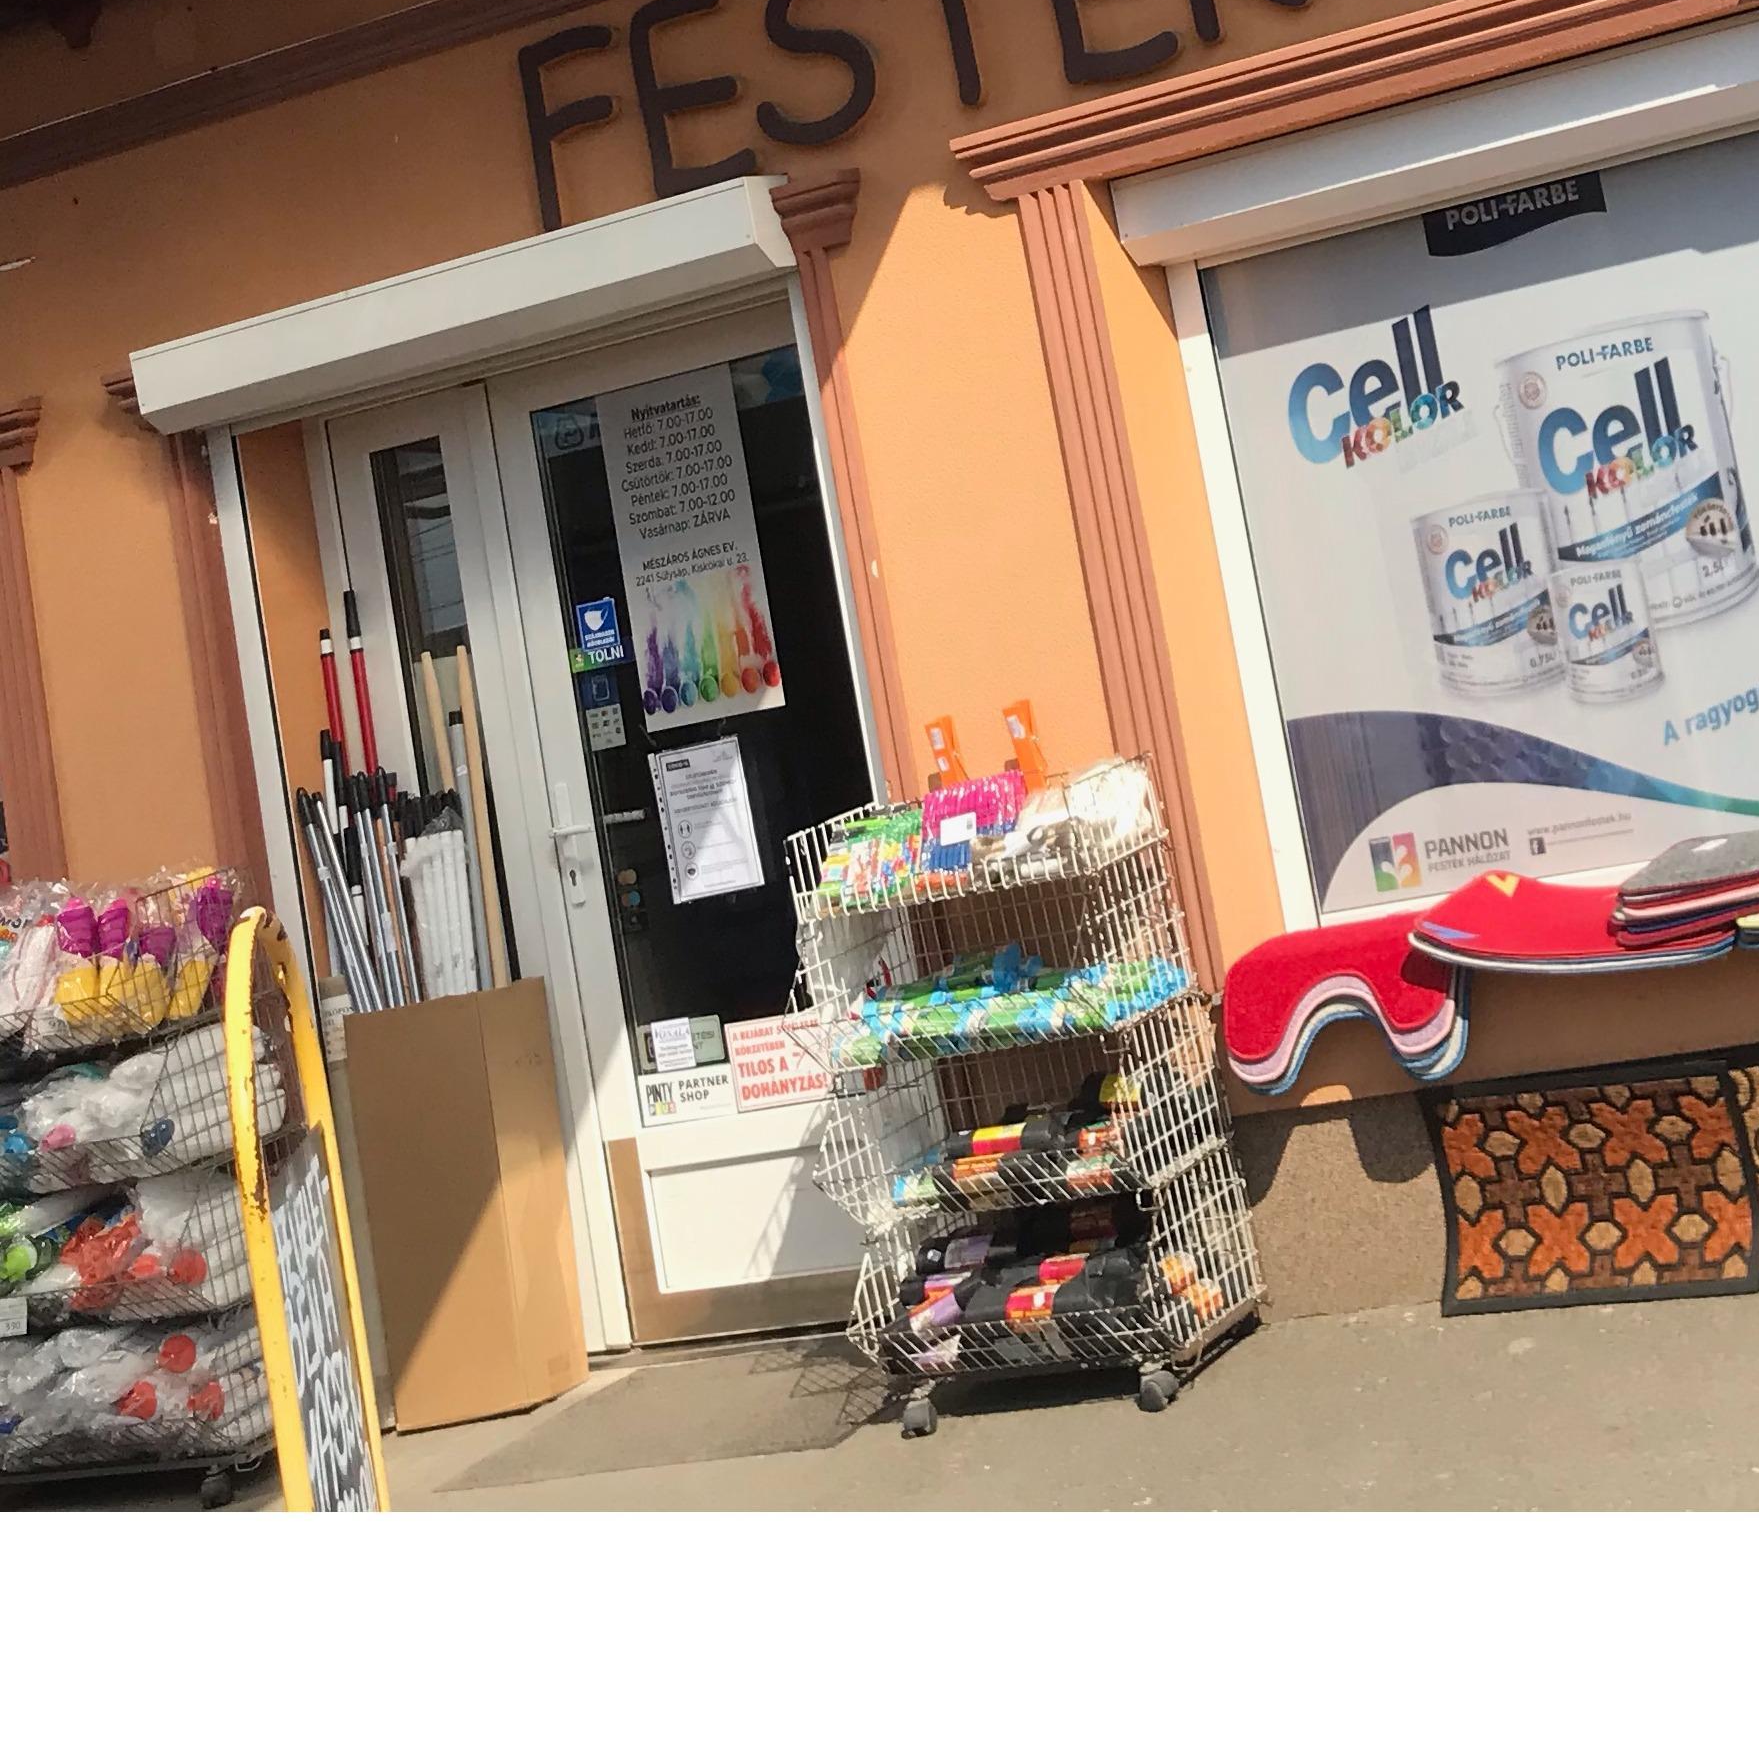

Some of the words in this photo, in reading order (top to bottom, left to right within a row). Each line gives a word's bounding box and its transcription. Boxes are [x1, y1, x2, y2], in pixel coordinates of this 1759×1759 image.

[1445, 180, 1580, 231] POLI-FARBE
[1556, 337, 1654, 371] POLI-FARBE
[1288, 305, 1444, 464] Cell
[631, 394, 701, 421] Nyitvatartás:
[657, 407, 713, 431] 7.00-17.00
[659, 424, 715, 448] 7.00-17.00
[1341, 381, 1464, 469] KOLOR
[1538, 357, 1682, 495] Cell
[666, 440, 722, 463] 7.00-17.00
[1586, 424, 1698, 499] KOLOR
[676, 455, 732, 479] 7.00-17.00
[672, 473, 728, 497] 7.00-17.00
[679, 489, 735, 513] 7.00-12.00
[693, 508, 731, 528] ZÁRVA
[1445, 522, 1523, 599] Cell
[1569, 584, 1627, 640] Cell
[588, 644, 624, 664] TOLNI
[1664, 720, 1680, 745] A
[1425, 828, 1509, 858] PANNON
[738, 1058, 775, 1078] TILOS
[779, 1056, 789, 1072] A
[678, 1074, 729, 1090] PARTNER
[741, 1071, 829, 1101] DOHÁNYZÁS!
[679, 1090, 710, 1103] SHOP
